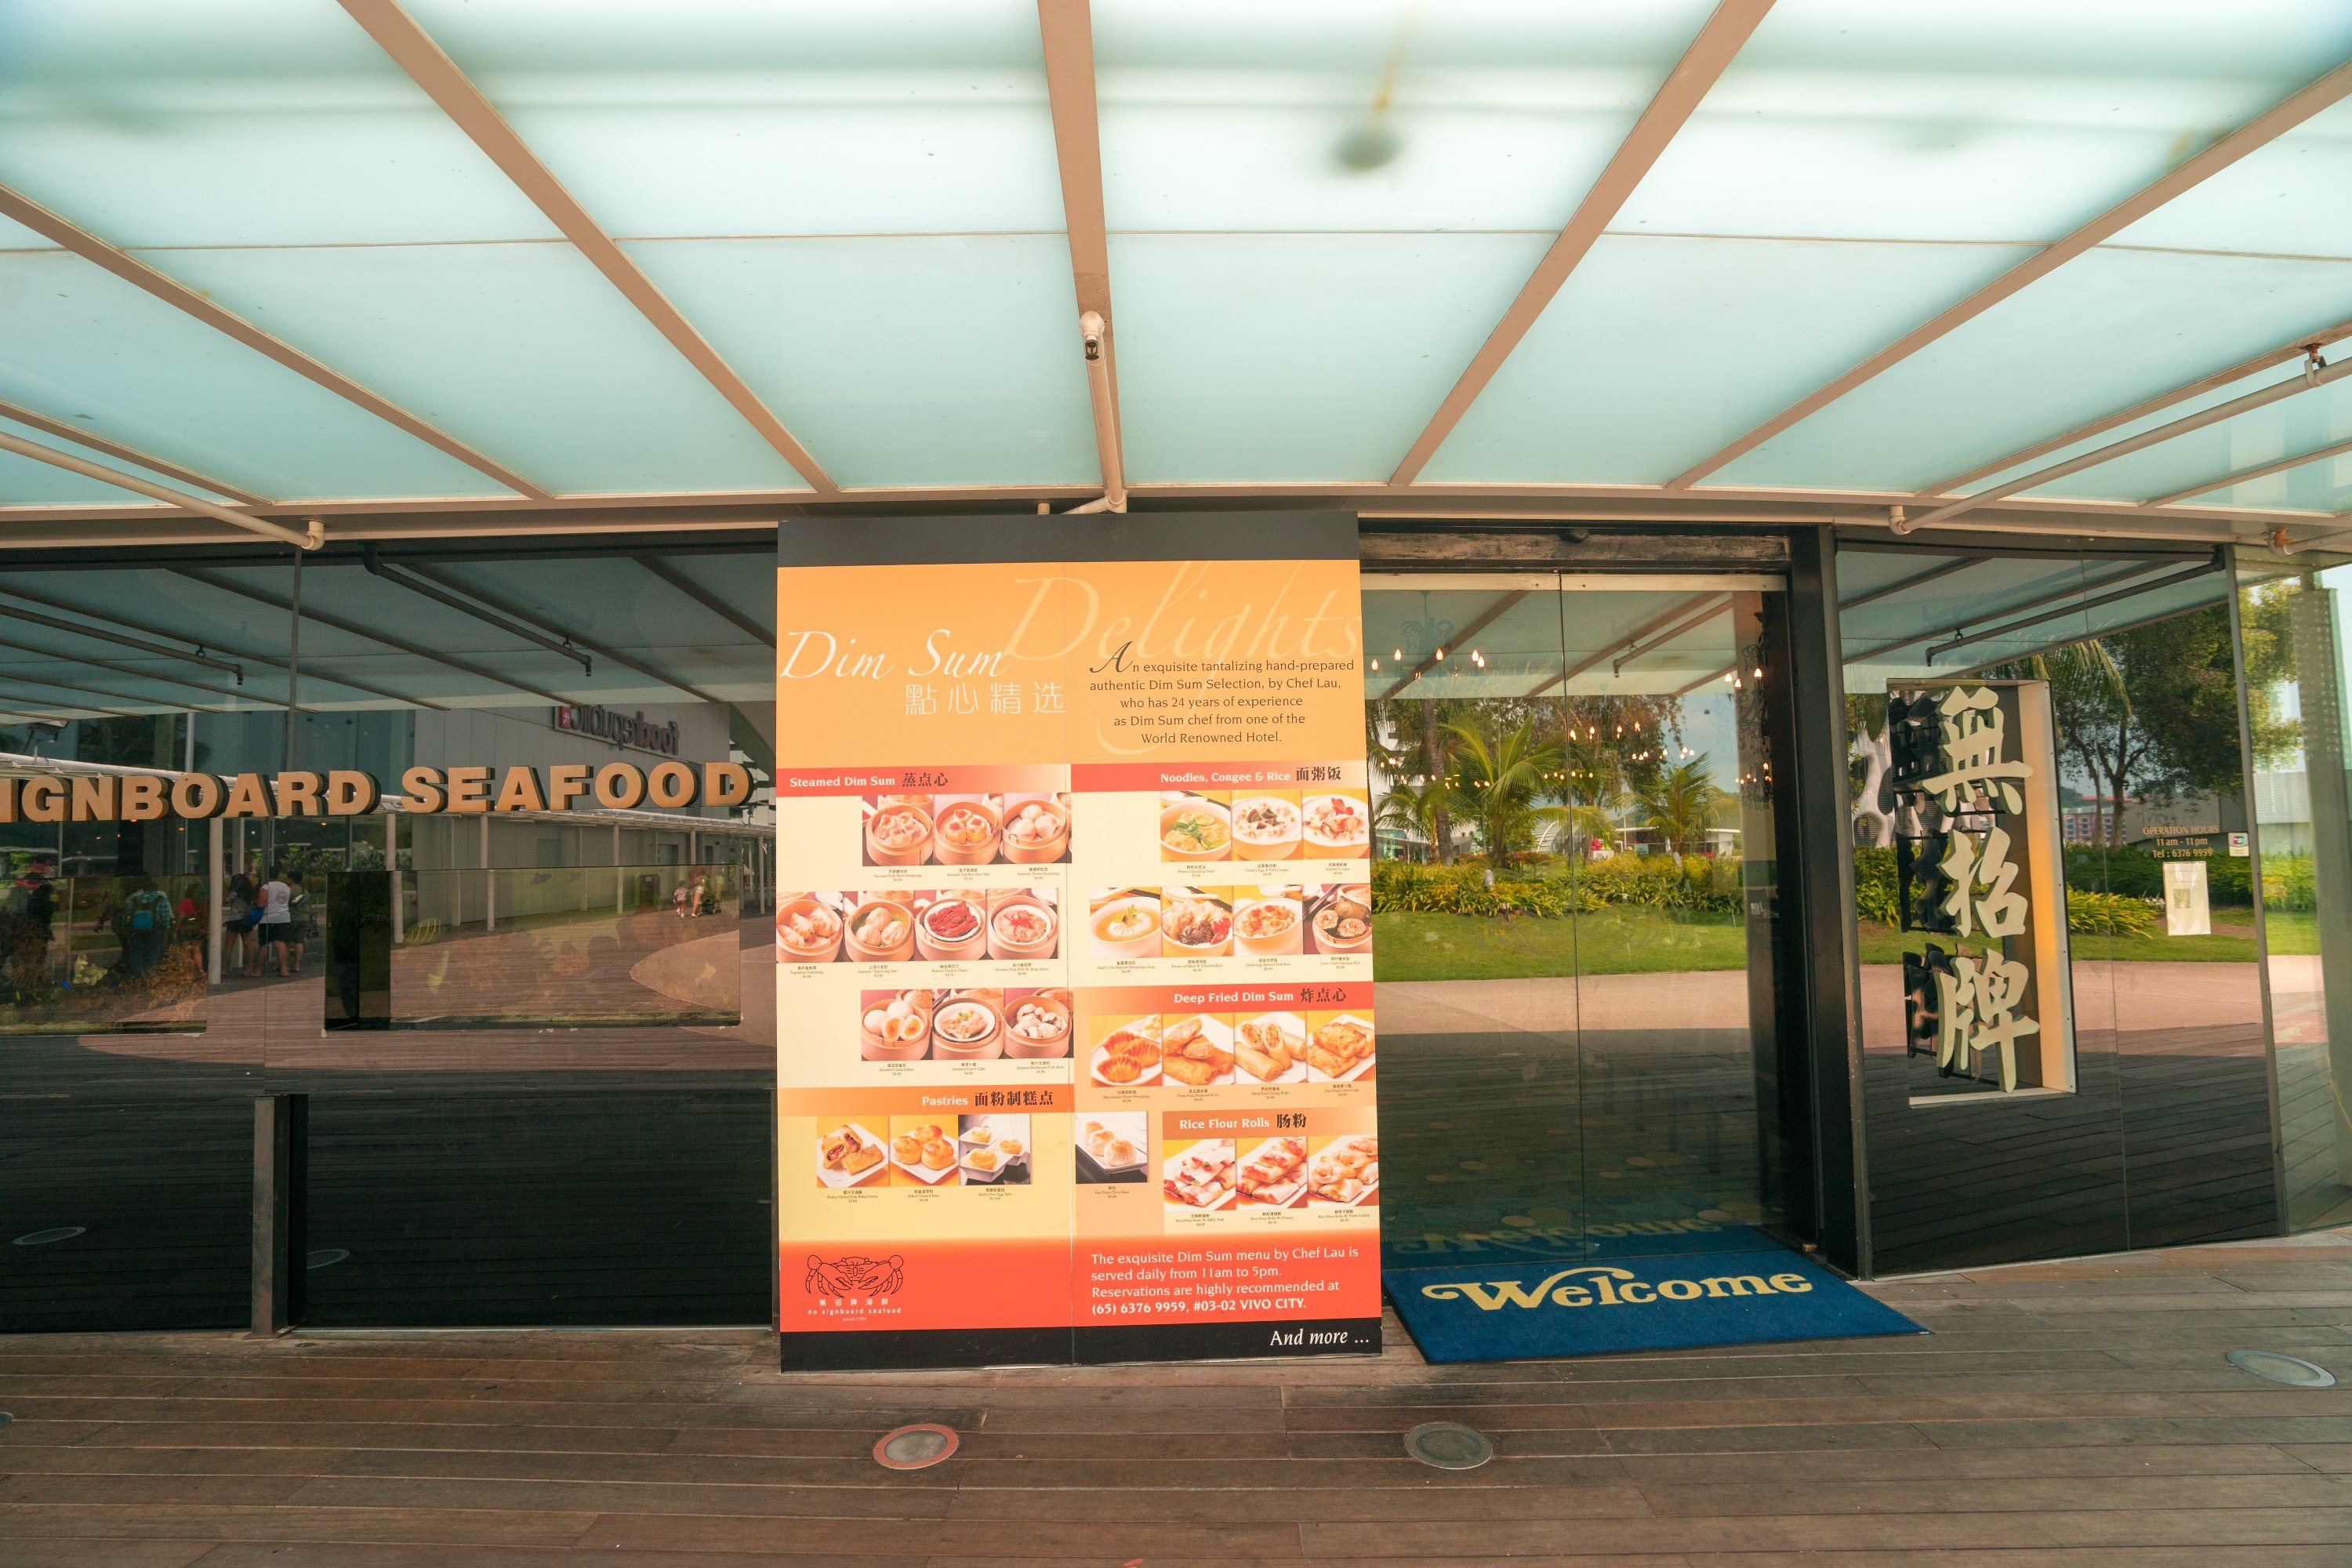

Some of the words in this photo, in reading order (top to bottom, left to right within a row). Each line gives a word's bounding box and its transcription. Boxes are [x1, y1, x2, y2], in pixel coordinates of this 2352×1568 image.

[780, 631, 895, 679] Dim
[909, 629, 1011, 677] Sum
[1001, 561, 1363, 755] Delights
[1090, 641, 1139, 673] An
[1144, 661, 1198, 674] exquisite
[1202, 659, 1262, 673] tantalizing
[1266, 659, 1354, 673] hand-prepared
[1090, 680, 1145, 691] authentic
[1149, 680, 1173, 690] Dim
[1177, 679, 1202, 690] Sum
[1206, 678, 1265, 691] Selection,
[1269, 678, 1283, 691] by
[1287, 678, 1313, 689] Chef
[1317, 677, 1341, 690] Lau,
[1120, 698, 1145, 708] who
[1148, 697, 1167, 708] has
[1171, 697, 1185, 707] 24
[1189, 699, 1219, 710] years
[1223, 696, 1235, 707] of
[1238, 696, 1303, 709] experience
[1131, 715, 1154, 726] Dim
[1158, 716, 1184, 726] Sum
[1188, 714, 1213, 725] chef
[1216, 714, 1243, 725] from
[1272, 713, 1283, 724] of
[1287, 713, 1305, 724] the
[1142, 733, 1176, 743] World
[1180, 732, 1242, 742] Renowned
[1247, 731, 1282, 742] Hotel.
[790, 777, 840, 787] Steamed
[844, 776, 866, 786] Dim
[870, 776, 895, 786] Sum
[902, 772, 948, 787] 蒸点心
[1160, 773, 1208, 784] Noodles,
[1211, 773, 1251, 785] Congee
[1255, 772, 1263, 782] &
[1267, 771, 1290, 781] Rice
[1296, 767, 1341, 782] 面粥饭
[401, 760, 753, 813] SEAFOOD
[2143, 826, 2188, 835] OPERATION
[2190, 825, 2220, 833] HOURS
[2172, 849, 2190, 858] 6376
[1921, 686, 2039, 1093] 無招牌
[1174, 993, 1205, 1004] Deep
[1208, 992, 1238, 1003] Fried
[1242, 992, 1265, 1002] Dim
[1269, 991, 1294, 1002] Sum
[1301, 988, 1347, 1003] 炸点心
[922, 1095, 968, 1106] Pastries
[975, 1091, 1054, 1107] 面粉制糕点
[1180, 1119, 1205, 1130] Rice
[1209, 1118, 1238, 1129] Flour
[1242, 1117, 1269, 1128] Rolls
[1276, 1113, 1307, 1129] 肠粉
[1091, 1254, 1114, 1265] The
[1117, 1253, 1174, 1266] exquisite
[1178, 1252, 1202, 1262] Dim
[1206, 1251, 1232, 1261] Sum
[1236, 1251, 1270, 1261] menu
[1274, 1249, 1289, 1262] by
[1292, 1248, 1320, 1259] Chef
[1323, 1248, 1345, 1258] Lau
[1348, 1247, 1359, 1257] is
[1091, 1270, 1133, 1281] served
[1137, 1269, 1166, 1282] daily
[1170, 1269, 1197, 1279] from
[1202, 1268, 1232, 1279] 11am
[1236, 1268, 1248, 1278] to
[1252, 1267, 1282, 1280] 5pm.
[1092, 1286, 1170, 1298] Reservations
[1174, 1287, 1192, 1296] are
[1196, 1283, 1232, 1297] highly
[1236, 1281, 1324, 1294] recommended
[1328, 1280, 1340, 1291] at
[1422, 1267, 1813, 1311] Welcome
[1092, 1302, 1116, 1316] (65)
[1120, 1302, 1151, 1313] 6376
[1155, 1301, 1189, 1313] 9959,
[1193, 1300, 1236, 1312] #03-02
[1240, 1298, 1272, 1310] VIVO
[1275, 1298, 1306, 1308] CITY.
[1270, 1330, 1304, 1347] And
[1309, 1330, 1348, 1345] more
